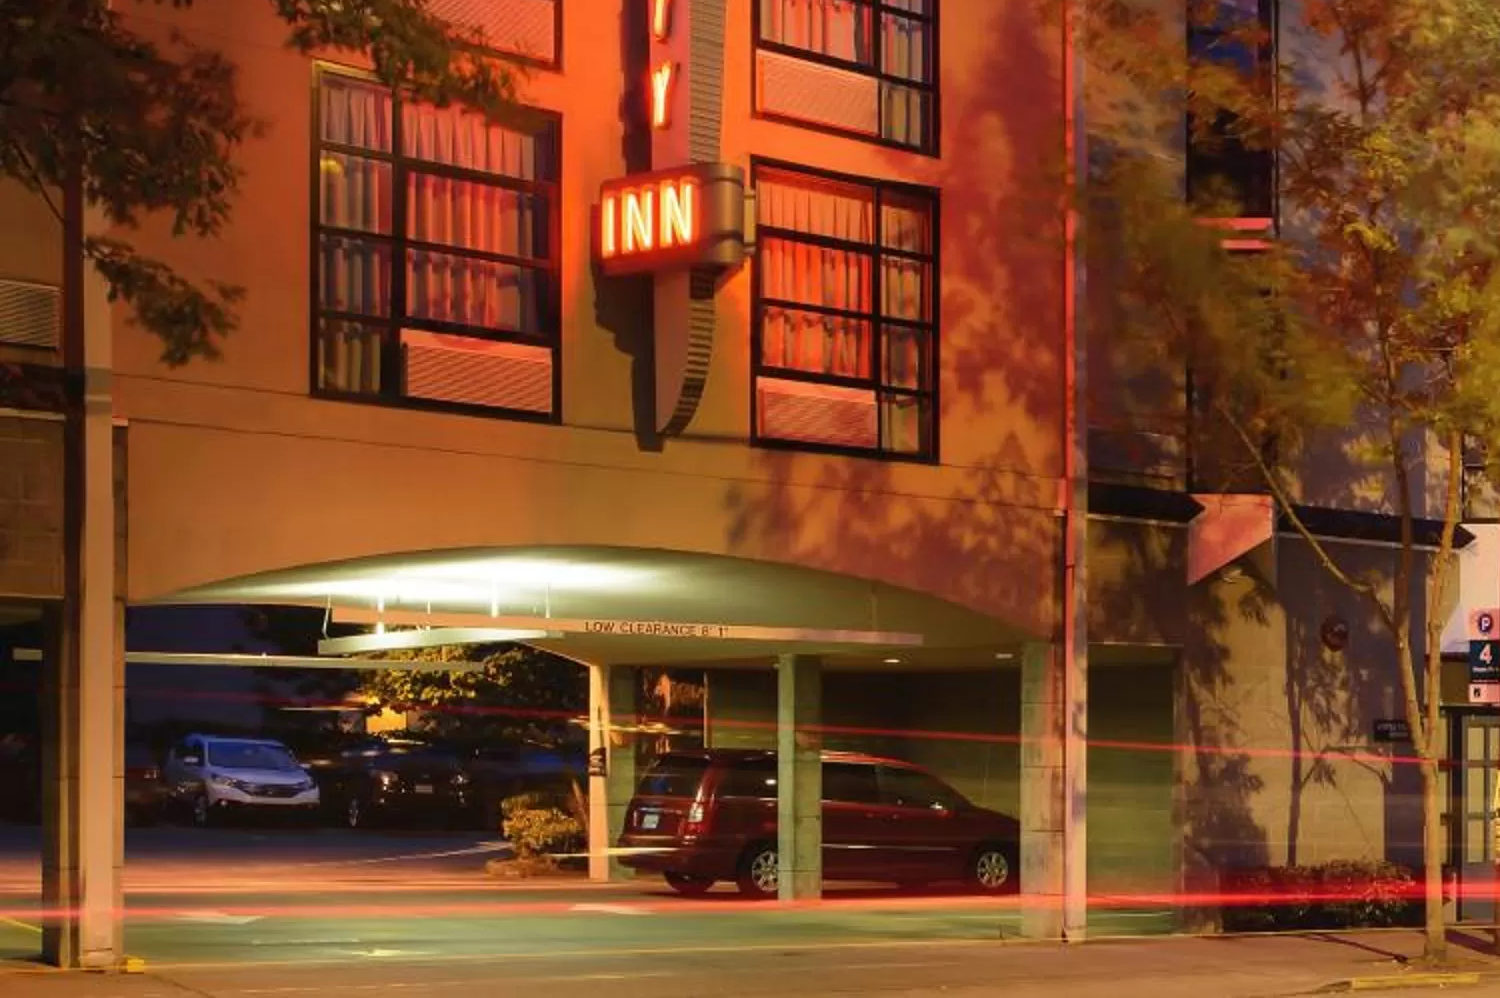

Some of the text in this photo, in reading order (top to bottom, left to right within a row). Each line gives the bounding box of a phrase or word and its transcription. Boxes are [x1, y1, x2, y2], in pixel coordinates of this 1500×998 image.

[602, 176, 699, 258] INN
[585, 622, 614, 632] LOW
[620, 622, 696, 635] CLEARANCE
[1481, 617, 1491, 631] P
[1479, 643, 1492, 664] 4
